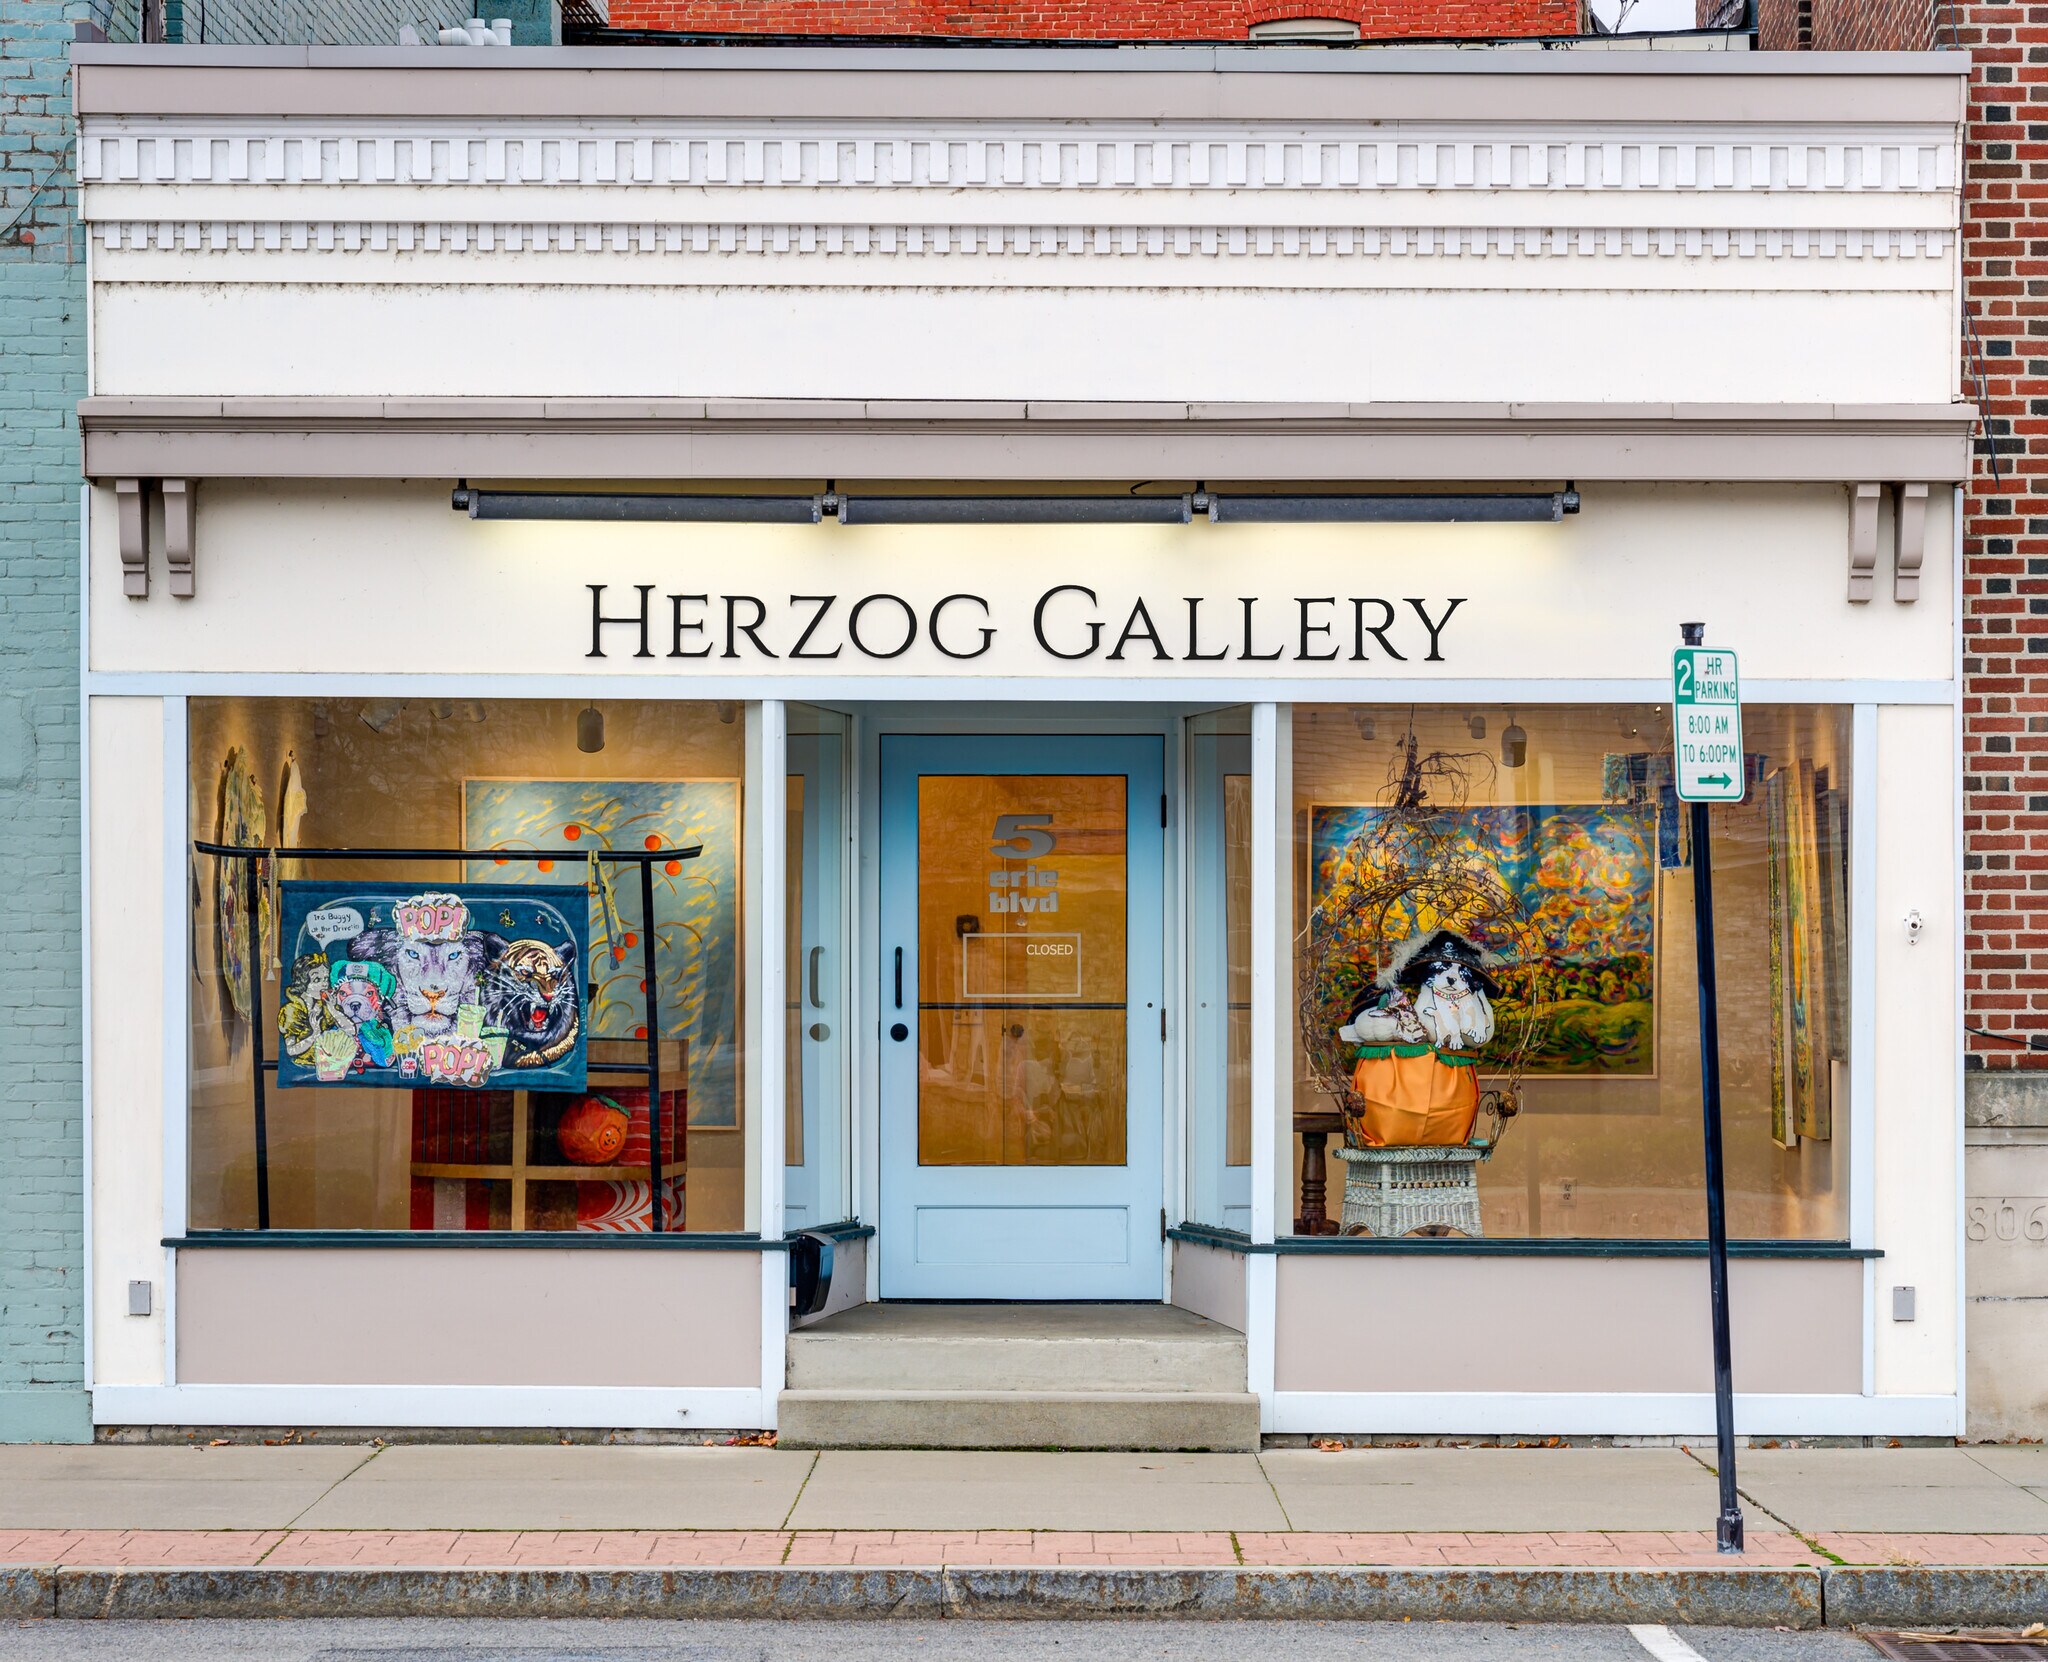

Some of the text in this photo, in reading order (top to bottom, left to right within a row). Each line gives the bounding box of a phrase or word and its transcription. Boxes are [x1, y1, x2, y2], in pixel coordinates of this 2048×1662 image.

[584, 584, 1468, 661] HERZOG GALLERY
[1677, 657, 1722, 696] 2 HR
[1695, 681, 1736, 700] PARKING
[1688, 715, 1729, 734] 8:00 AM
[1683, 744, 1737, 763] TO 6:00PM
[989, 814, 1057, 860] 5
[988, 865, 1059, 888] erie
[988, 891, 1059, 913] blvd
[399, 904, 464, 939] POP!
[1026, 944, 1073, 956] CLOSED
[423, 1043, 489, 1082] POP!
